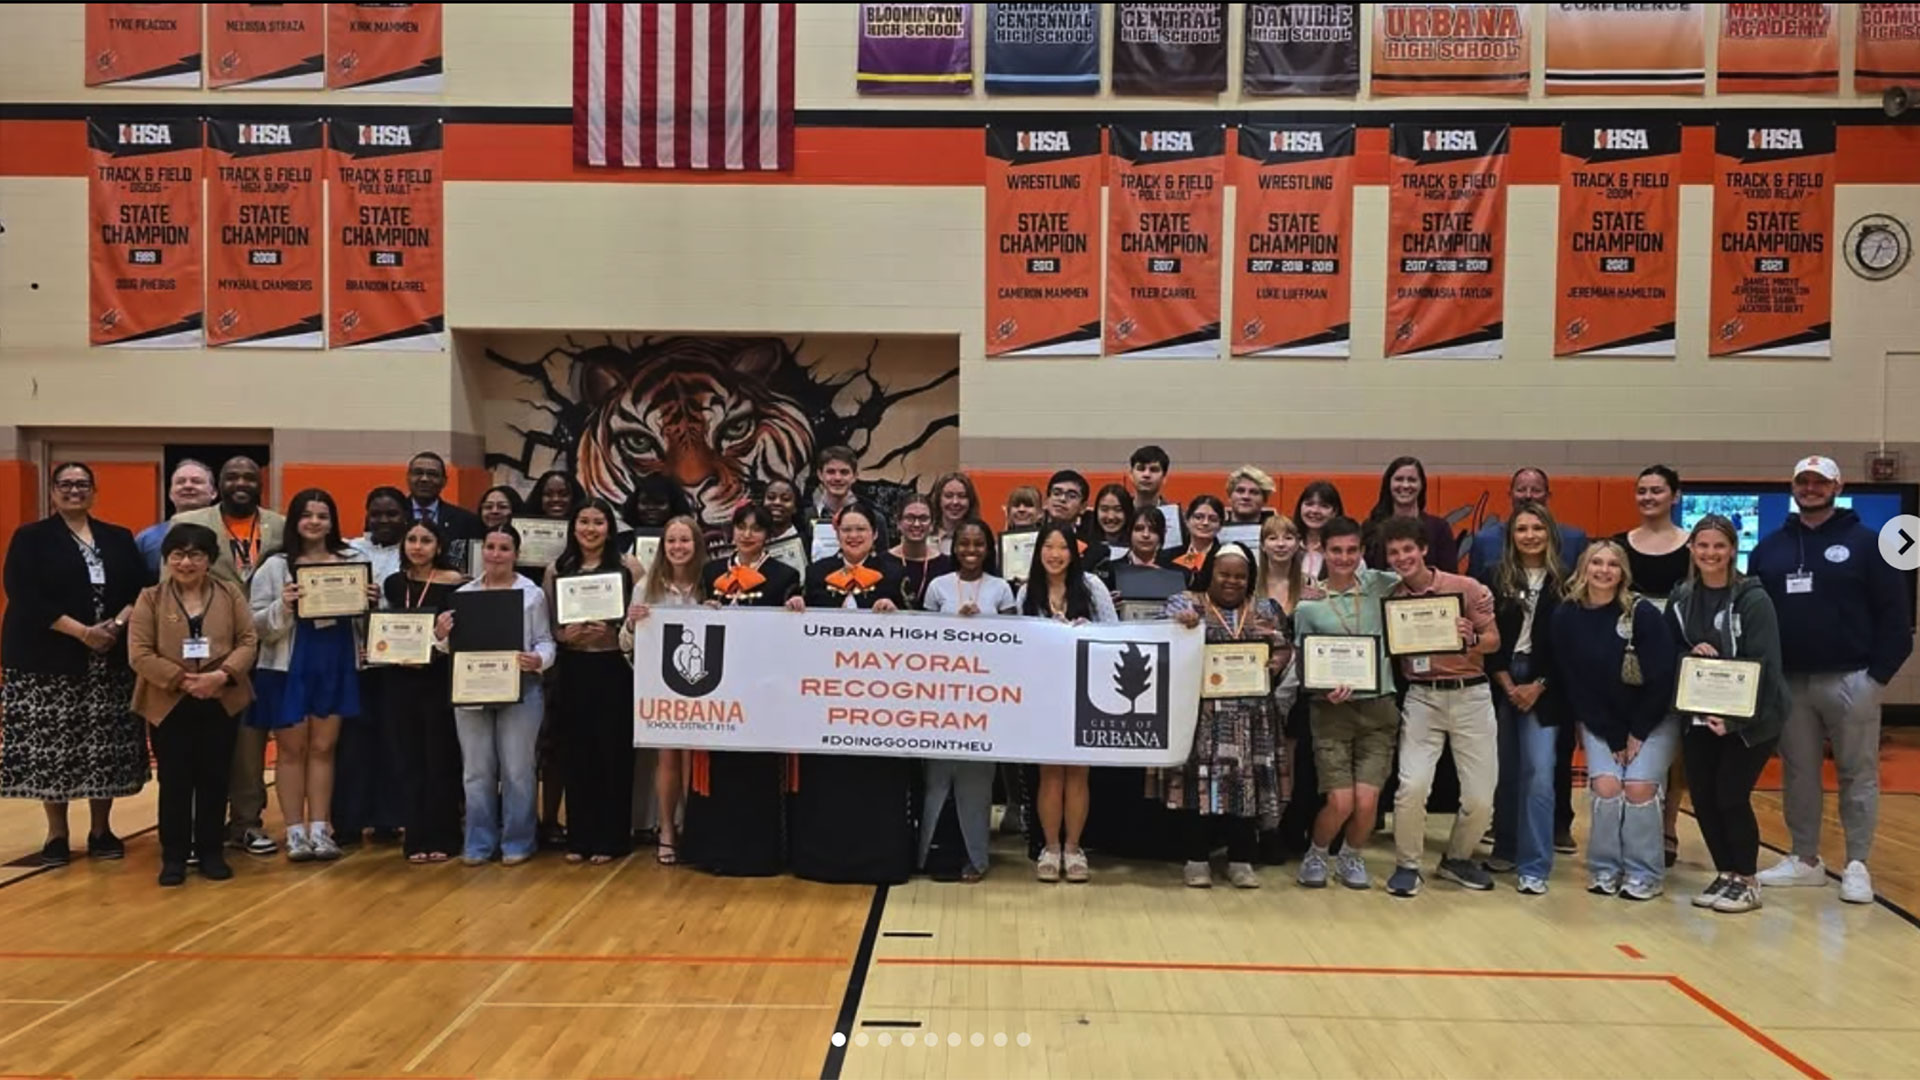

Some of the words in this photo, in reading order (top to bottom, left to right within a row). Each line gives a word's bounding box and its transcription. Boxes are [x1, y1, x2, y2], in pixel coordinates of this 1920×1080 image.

[866, 6, 963, 23] BLOOMINGTON
[996, 12, 1093, 29] CENTENNIAL
[1122, 11, 1220, 29] CENTRAL
[1254, 6, 1351, 27] DANVILLE
[1385, 6, 1520, 38] URBANA
[136, 19, 177, 31] PEACOCK
[269, 20, 305, 32] STRAZA
[350, 22, 372, 33] KIRK
[374, 22, 419, 33] MAMMEN
[866, 24, 901, 37] HIGH
[905, 24, 963, 37] SCHOOL
[1728, 18, 1828, 37] ACADEMY
[996, 29, 1031, 43] HIGH
[1035, 29, 1093, 43] SCHOOL
[1122, 28, 1154, 42] HIGH
[1161, 29, 1220, 43] SCHOOL
[1254, 28, 1288, 41] HIGH
[1292, 28, 1351, 42] SCHOOL
[1385, 40, 1433, 59] HIGH
[1440, 40, 1519, 59] SCHOOL
[99, 167, 140, 182] TRACK
[159, 167, 192, 182] FIELD
[218, 167, 260, 182] TRACK
[278, 167, 312, 182] FIELD
[339, 168, 380, 183] TRACK
[398, 169, 432, 184] FIELD
[1007, 174, 1080, 189] WRESTLING
[1121, 174, 1160, 189] TRACK
[1179, 175, 1213, 189] FIELD
[1258, 174, 1333, 190] WRESTLING
[1402, 174, 1444, 189] TRACK
[1462, 174, 1496, 189] FIELD
[1572, 173, 1614, 187] TRACK
[1633, 173, 1669, 187] FIELD
[1726, 172, 1769, 187] TRACK
[1788, 172, 1824, 188] FIELD
[264, 183, 290, 193] JUMP
[358, 184, 381, 194] POLE
[384, 184, 411, 194] VAULT
[1138, 190, 1161, 200] POLE
[1164, 190, 1191, 200] VAULT
[1774, 188, 1805, 199] RELAY
[120, 205, 170, 224] STATE
[240, 206, 290, 224] STATE
[360, 206, 411, 226] STATE
[1018, 213, 1069, 232] STATE
[1422, 213, 1473, 232] STATE
[1592, 212, 1645, 231] STATE
[1747, 212, 1799, 231] STATE
[1140, 213, 1191, 233] STATE
[1268, 213, 1320, 233] STATE
[102, 225, 189, 245] CHAMPION
[222, 226, 309, 245] CHAMPION
[342, 227, 429, 247] CHAMPION
[1403, 233, 1492, 253] CHAMPION
[1573, 232, 1663, 252] CHAMPION
[1722, 233, 1824, 253] CHAMPIONS
[1000, 234, 1087, 253] CHAMPION
[1121, 234, 1208, 253] CHAMPION
[1249, 234, 1338, 254] CHAMPION
[1032, 260, 1054, 271] 2013
[1154, 260, 1175, 271] 2017
[1252, 260, 1273, 271] 2017
[1282, 260, 1304, 271] 2018
[1312, 260, 1334, 271] 2019
[1405, 260, 1427, 271] 2017
[1606, 260, 1629, 271] 2021
[1761, 260, 1784, 271] 2021
[262, 280, 312, 291] CHAMBERS
[346, 280, 388, 291] BRANDON
[998, 288, 1042, 299] CAMERON
[1045, 288, 1088, 299] MAMMEN
[1130, 288, 1160, 299] TYLER
[1257, 288, 1281, 299] LUKE
[1460, 287, 1492, 299] TAYLOR
[1568, 287, 1615, 299] JEREMIAH
[1618, 287, 1666, 299] HAMILTON
[804, 624, 884, 638] URBANA
[890, 626, 938, 640] HIGH
[944, 628, 1023, 644] SCHOOL
[835, 651, 990, 674] MAYORAL
[801, 678, 1022, 704] RECOGNITION
[639, 699, 744, 723] URBANA
[647, 721, 677, 730] SCHOOL
[680, 722, 714, 730] DISTRICT
[828, 708, 988, 731] PROGRAM
[1091, 719, 1127, 729] CITY
[1137, 720, 1152, 729] OF
[822, 736, 993, 752] #DOINGGOODINTHEU
[1082, 730, 1161, 747] URBANA
